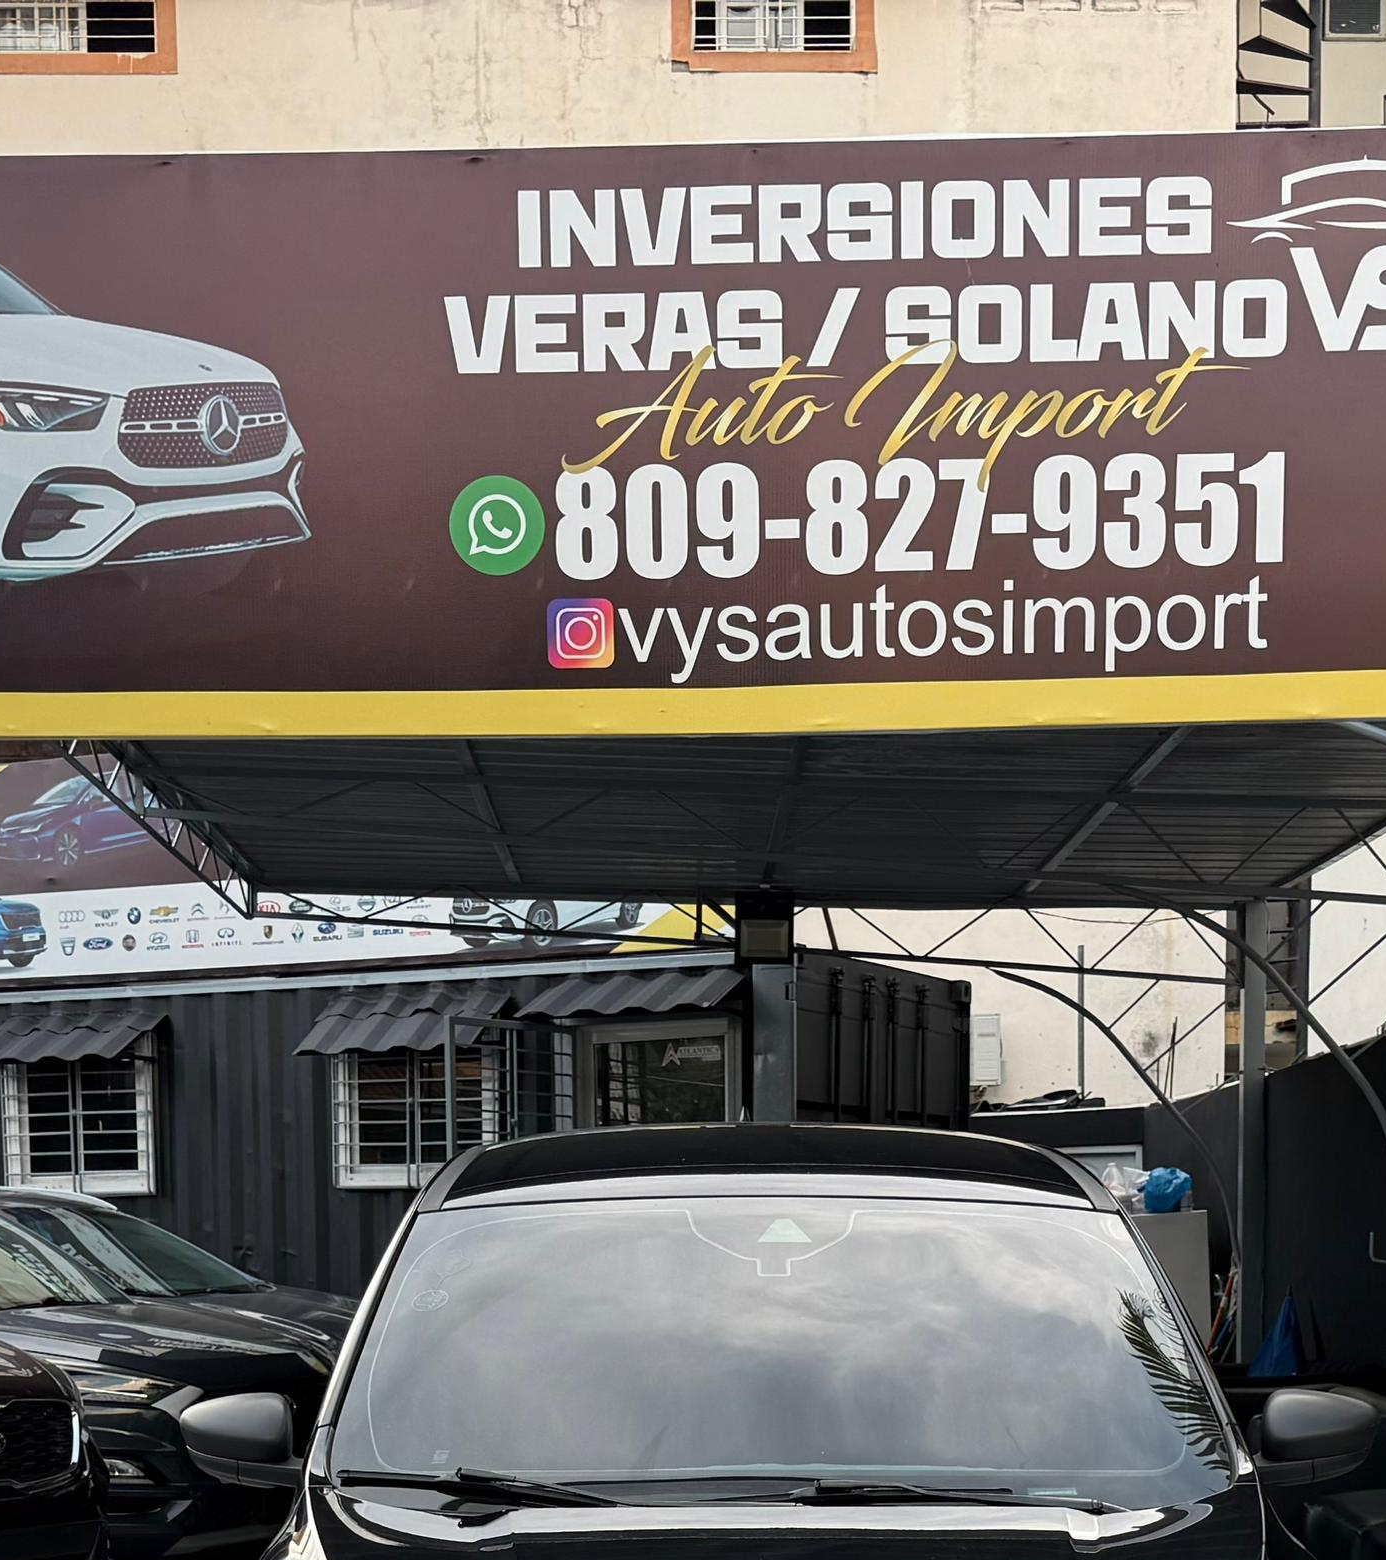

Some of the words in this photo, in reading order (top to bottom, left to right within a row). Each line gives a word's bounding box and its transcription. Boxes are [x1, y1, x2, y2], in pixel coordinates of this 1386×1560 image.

[517, 176, 1212, 268] INVERSIONES
[444, 290, 782, 374] VERAS
[806, 288, 860, 368] /
[885, 278, 1288, 364] SOLANO
[562, 345, 844, 474] Auto
[845, 339, 1251, 492] Import
[555, 451, 1286, 580] 809-827-9351
[618, 576, 1268, 683] vysautosimport
